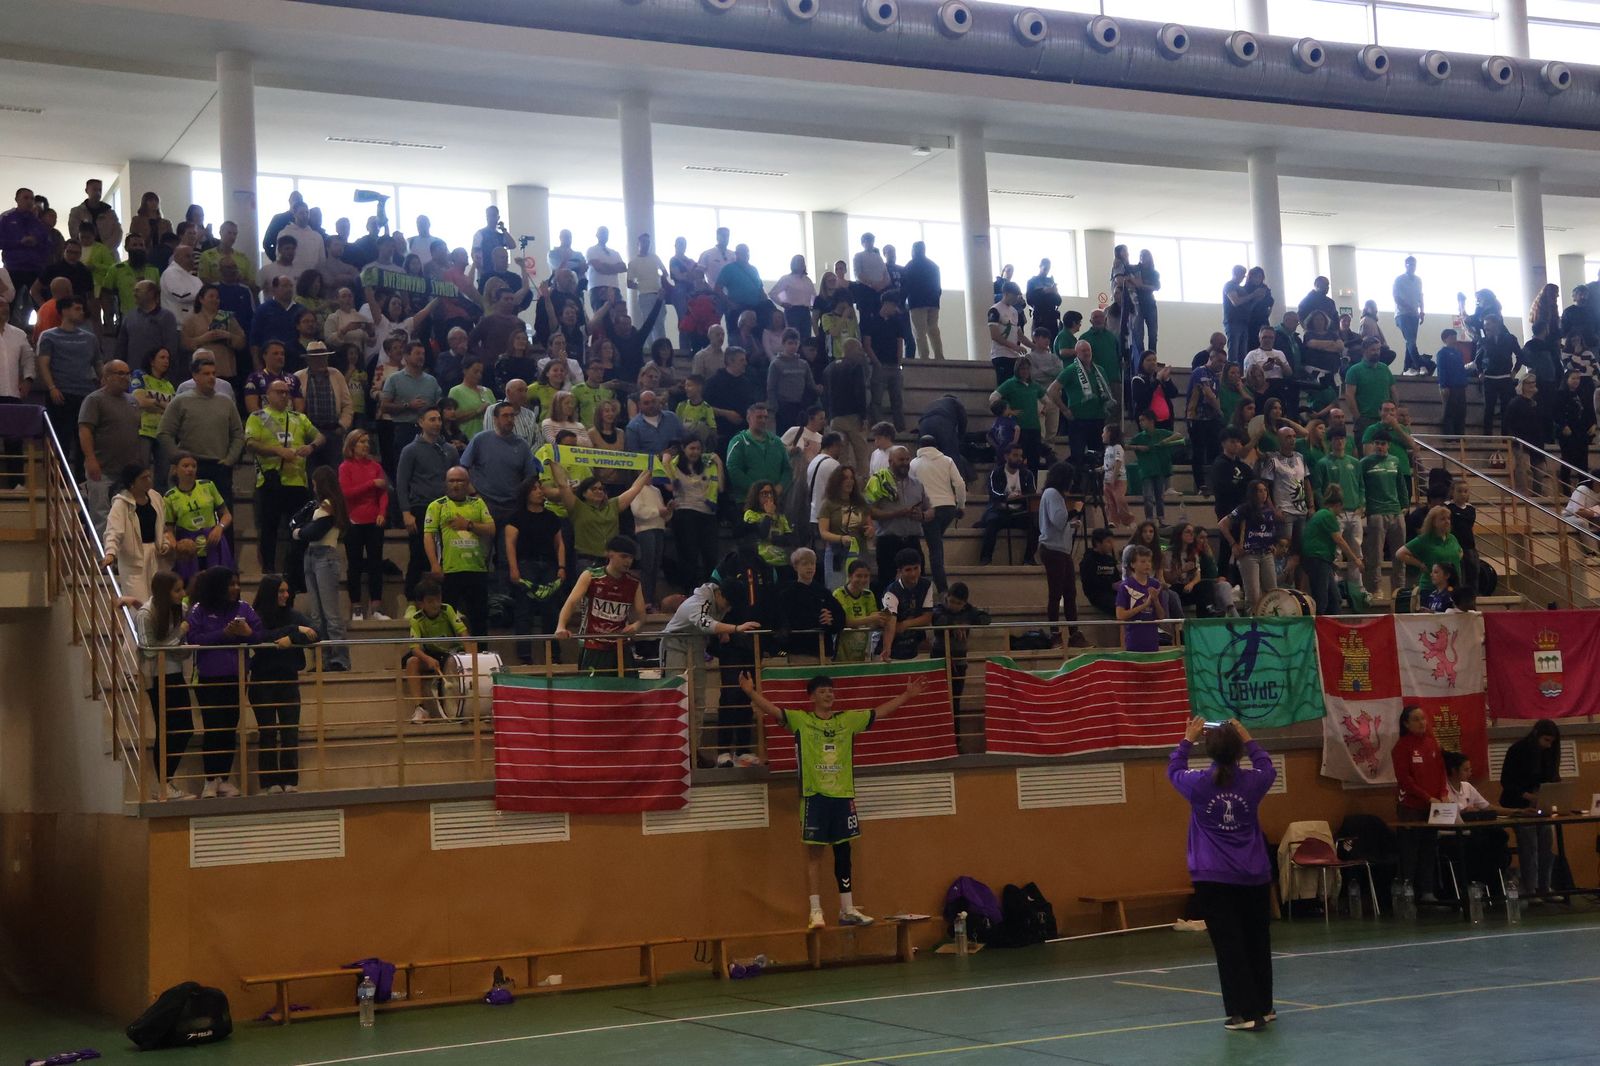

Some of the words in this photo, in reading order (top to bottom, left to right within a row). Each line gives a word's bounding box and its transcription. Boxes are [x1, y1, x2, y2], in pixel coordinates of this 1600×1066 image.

[575, 456, 589, 464] DE
[592, 458, 634, 467] VIRIATO
[847, 814, 858, 829] 69
